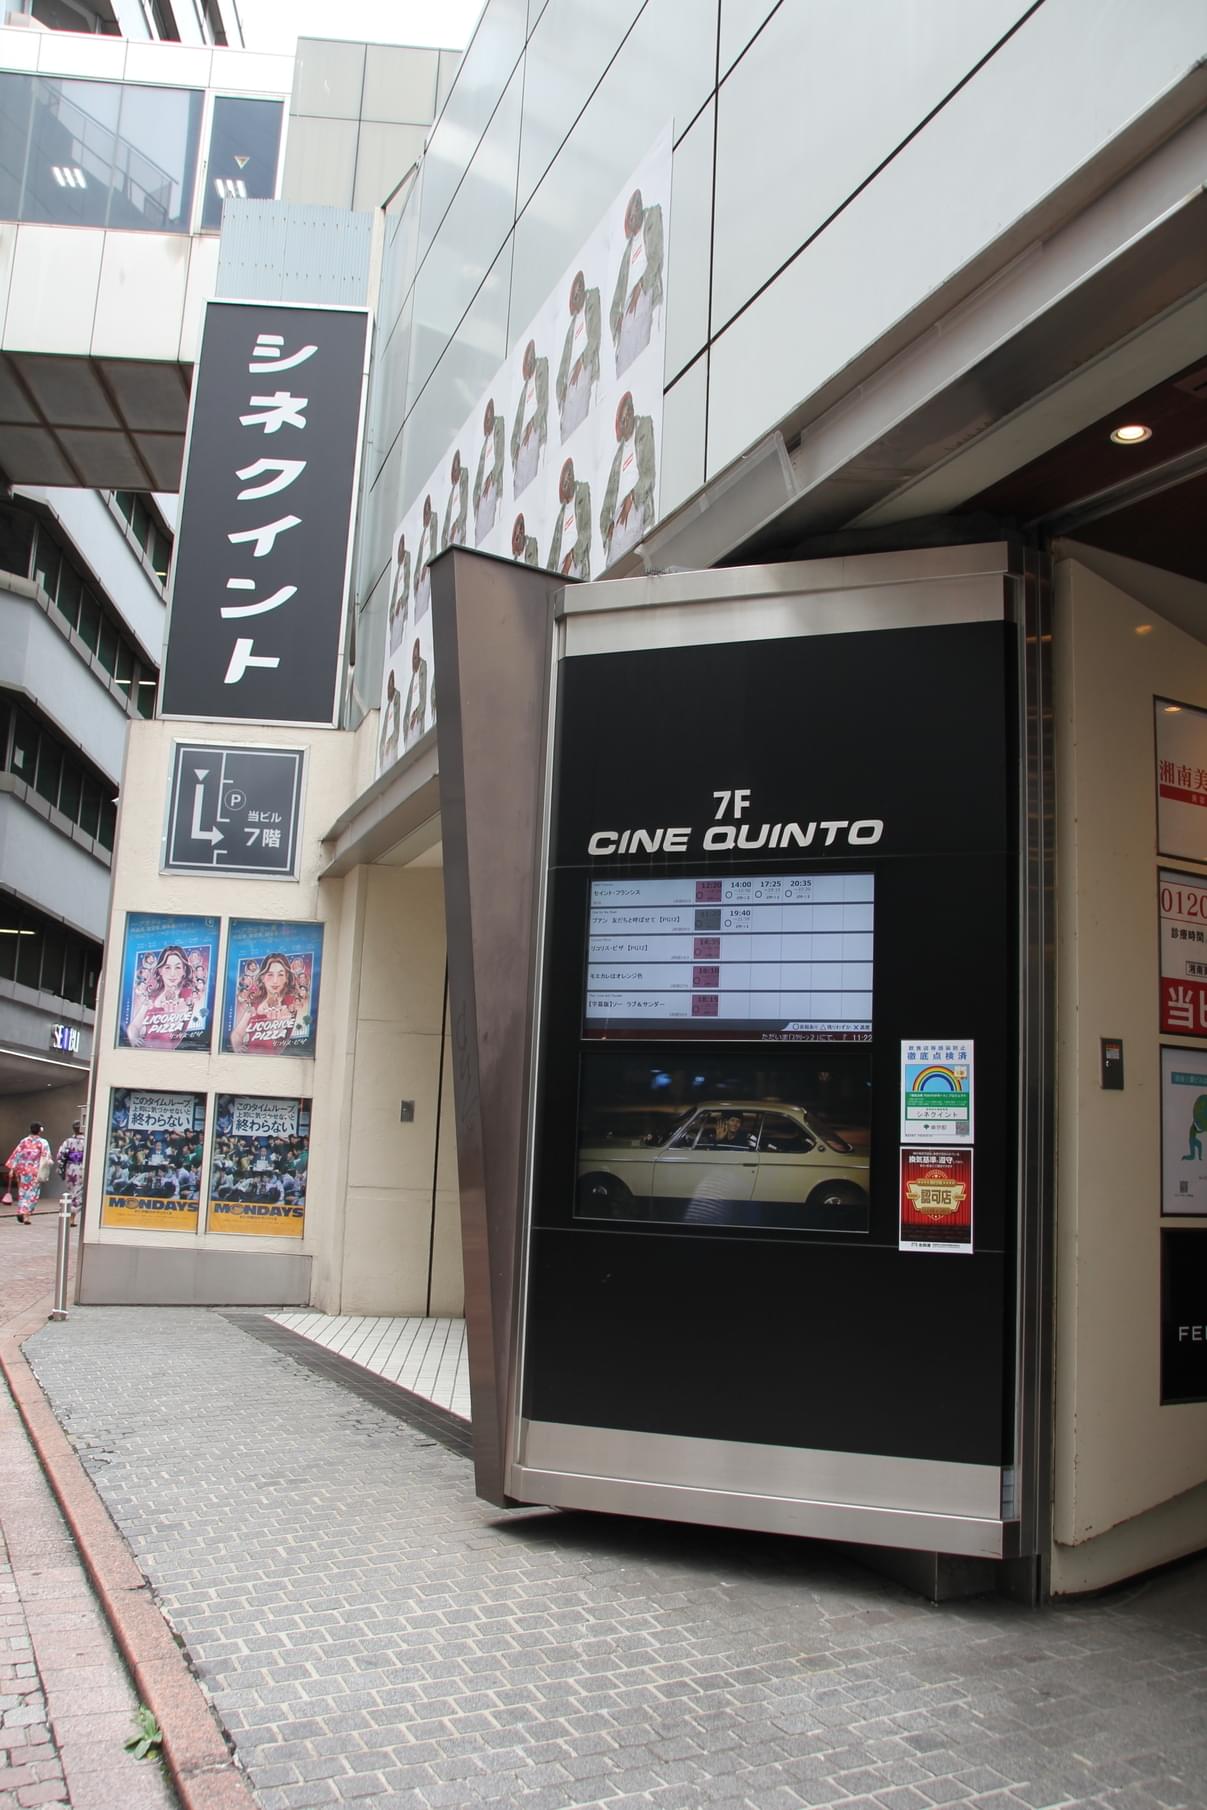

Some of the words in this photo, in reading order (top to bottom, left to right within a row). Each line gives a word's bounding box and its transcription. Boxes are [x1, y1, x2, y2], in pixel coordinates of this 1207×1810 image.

[218, 333, 319, 684] シネクイント
[713, 789, 751, 819] 7F
[247, 810, 282, 823] 当ビル
[243, 827, 281, 848] 7階
[587, 827, 692, 855] CINE
[703, 819, 884, 850] QUINTO
[760, 880, 782, 888] 17:25
[790, 879, 812, 887] 20:35
[148, 1022, 184, 1034] PIZZA
[246, 1019, 295, 1033] LICORICE
[251, 1029, 287, 1041] PIZZA
[131, 1112, 190, 1128] 終わらない
[235, 1119, 295, 1133] 終わらない
